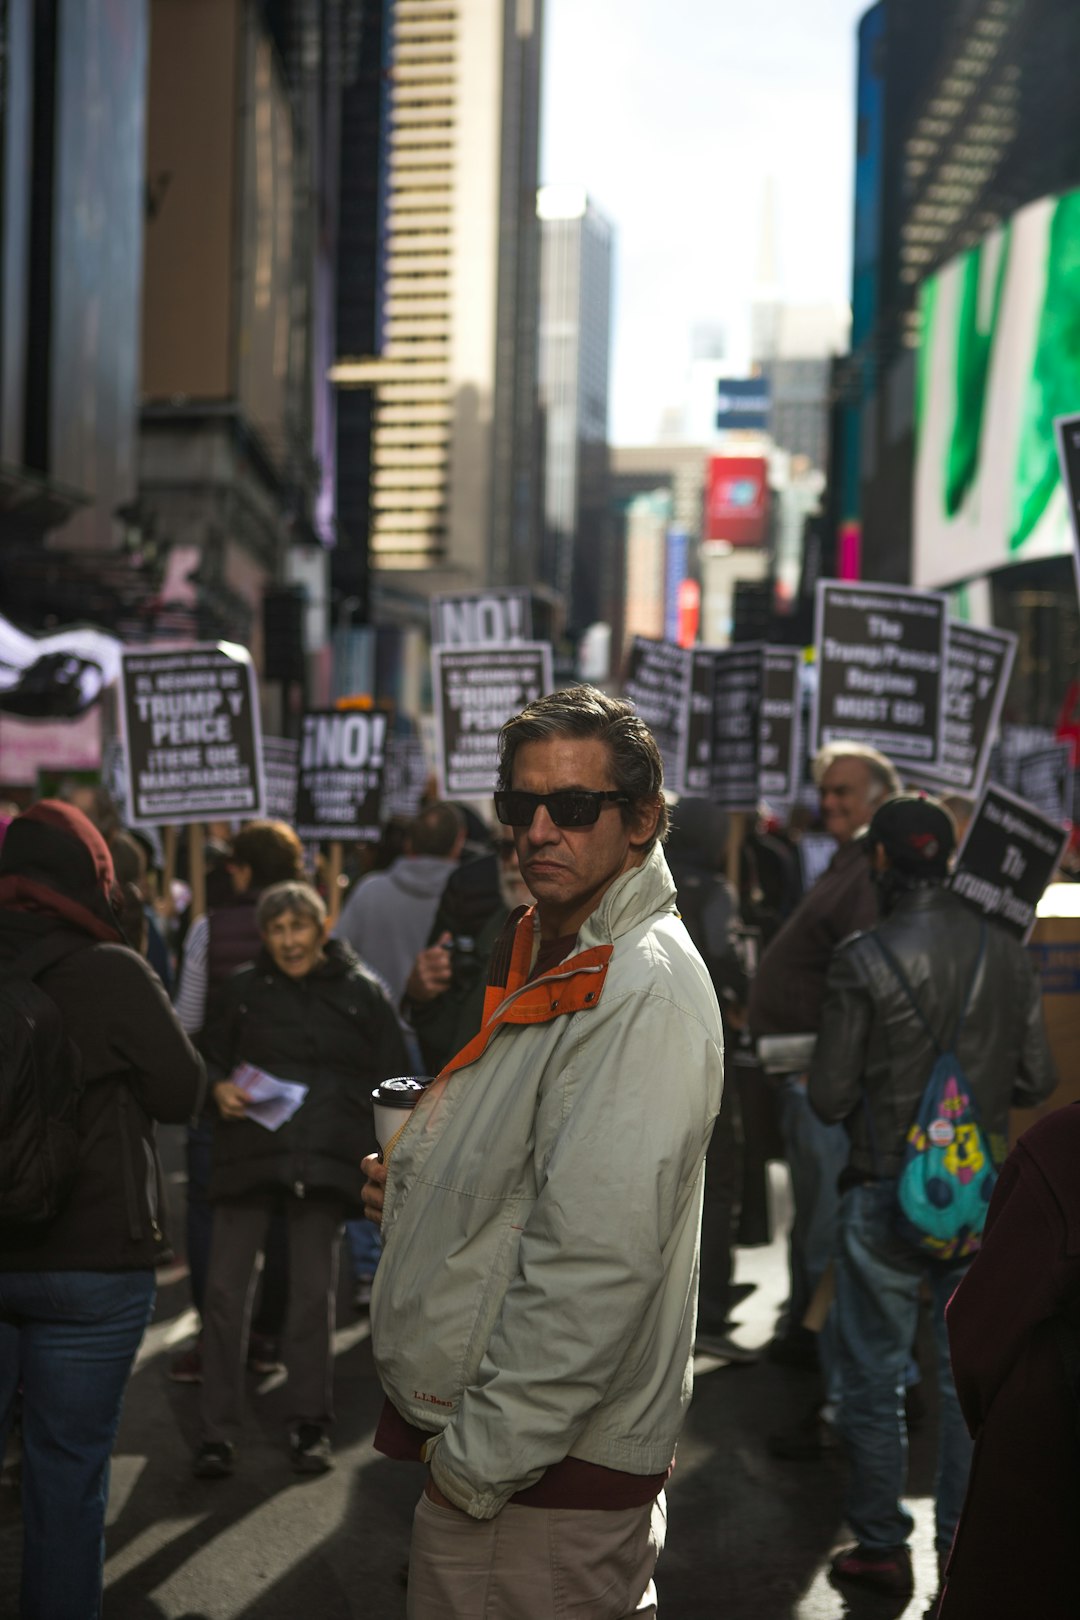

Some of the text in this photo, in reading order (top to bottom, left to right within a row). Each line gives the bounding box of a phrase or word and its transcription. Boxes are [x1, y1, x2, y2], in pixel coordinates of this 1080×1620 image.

[442, 596, 524, 646] NO!
[867, 615, 903, 640] The
[824, 637, 940, 673] Trump/Pence
[846, 667, 917, 696] Regime
[135, 691, 243, 722] TRUMP Y
[833, 695, 889, 722] MUST
[892, 702, 925, 727] GO!
[151, 714, 232, 747] PENCE
[302, 713, 386, 770] ¡NO!
[413, 1391, 453, 1408] L.L.Bean
